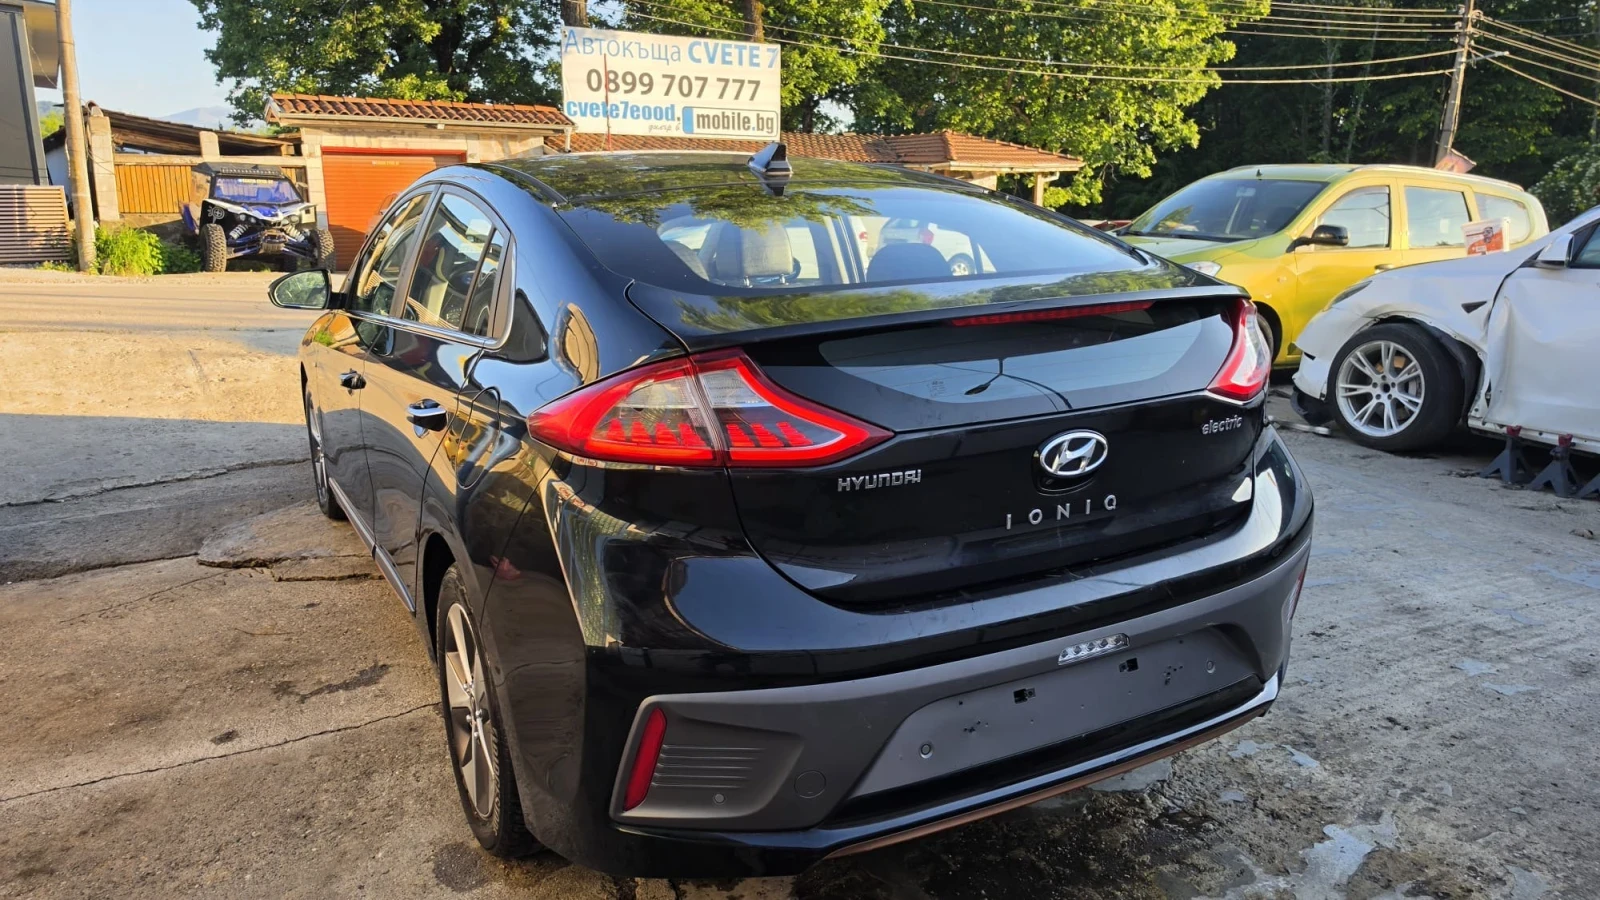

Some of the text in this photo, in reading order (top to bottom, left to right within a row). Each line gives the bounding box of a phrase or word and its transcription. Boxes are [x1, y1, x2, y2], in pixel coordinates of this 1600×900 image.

[564, 29, 778, 68] Автокъща CVETE 7
[586, 69, 761, 101] 0899 707 777
[696, 112, 774, 134] mobile.bg
[1202, 415, 1242, 434] electric
[837, 469, 921, 492] HYUNDAI
[1006, 495, 1117, 530] IONIQ
